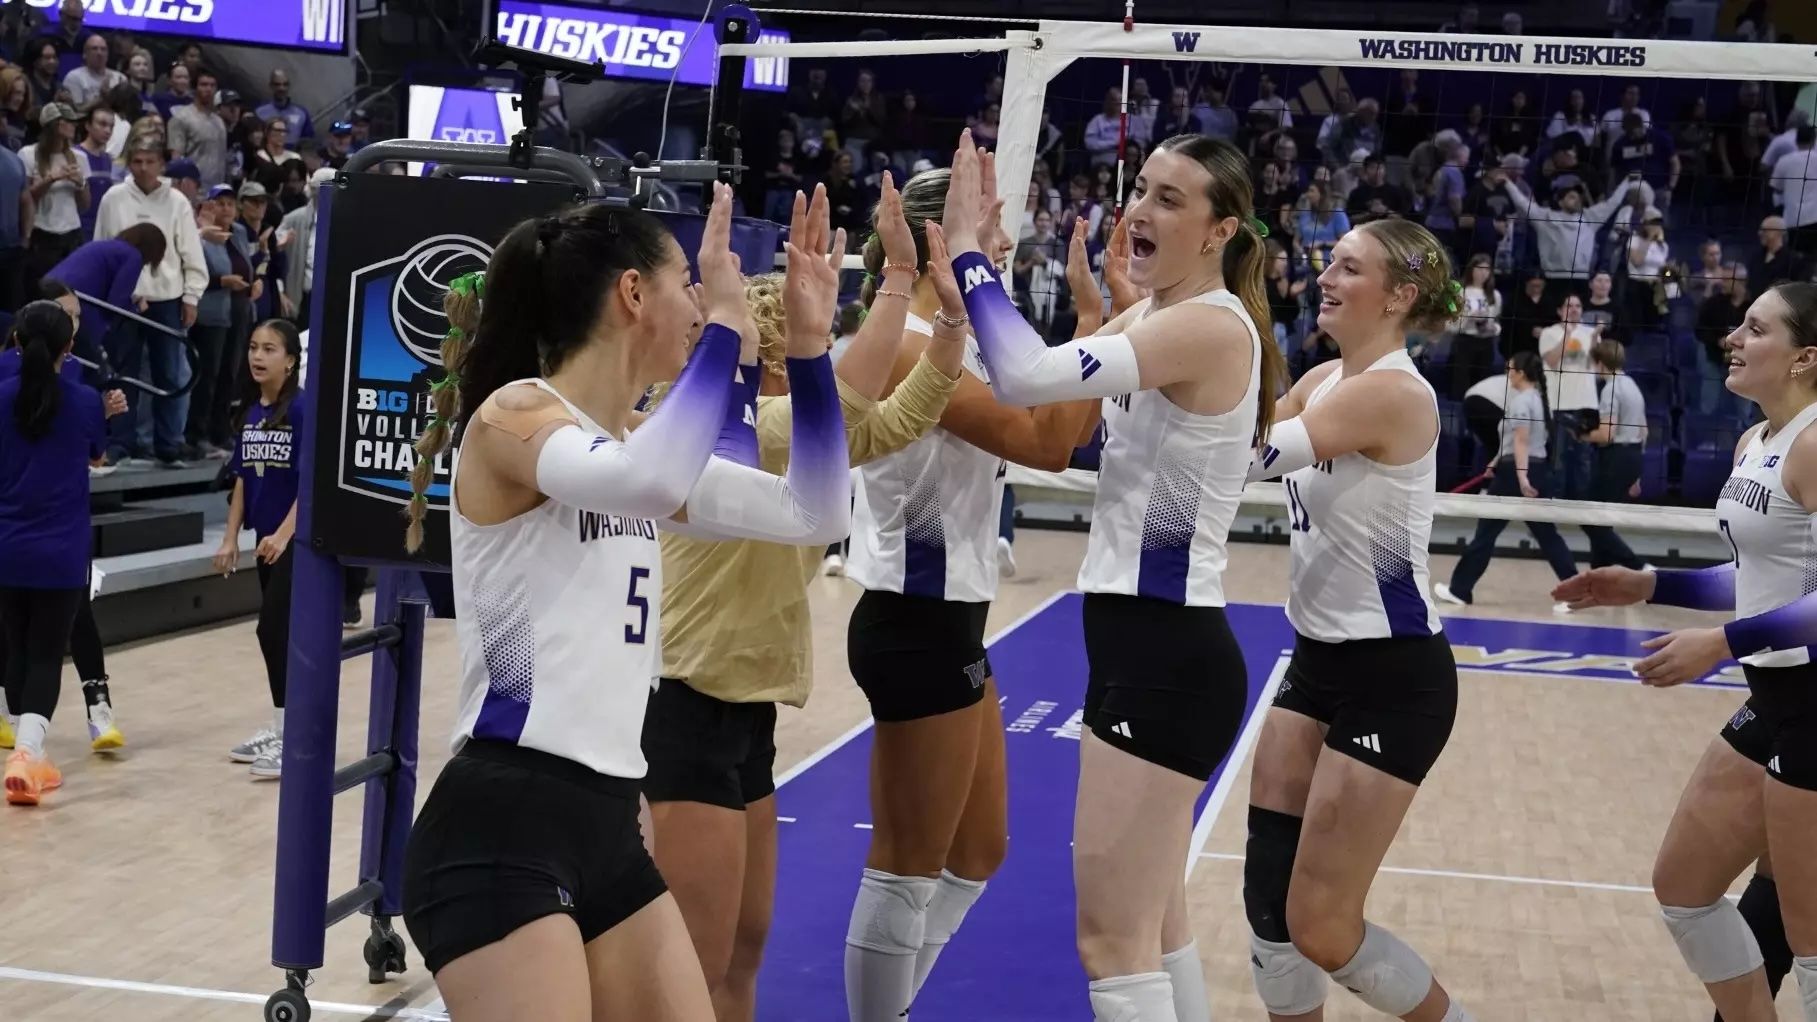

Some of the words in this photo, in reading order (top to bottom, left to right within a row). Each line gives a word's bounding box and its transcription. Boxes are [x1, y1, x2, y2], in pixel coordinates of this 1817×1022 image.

[497, 12, 686, 69] HUSKIES
[1171, 31, 1201, 52] W
[1358, 38, 1523, 63] WASHINGTON
[1533, 43, 1646, 67] HUSKIES
[624, 566, 651, 645] 5
